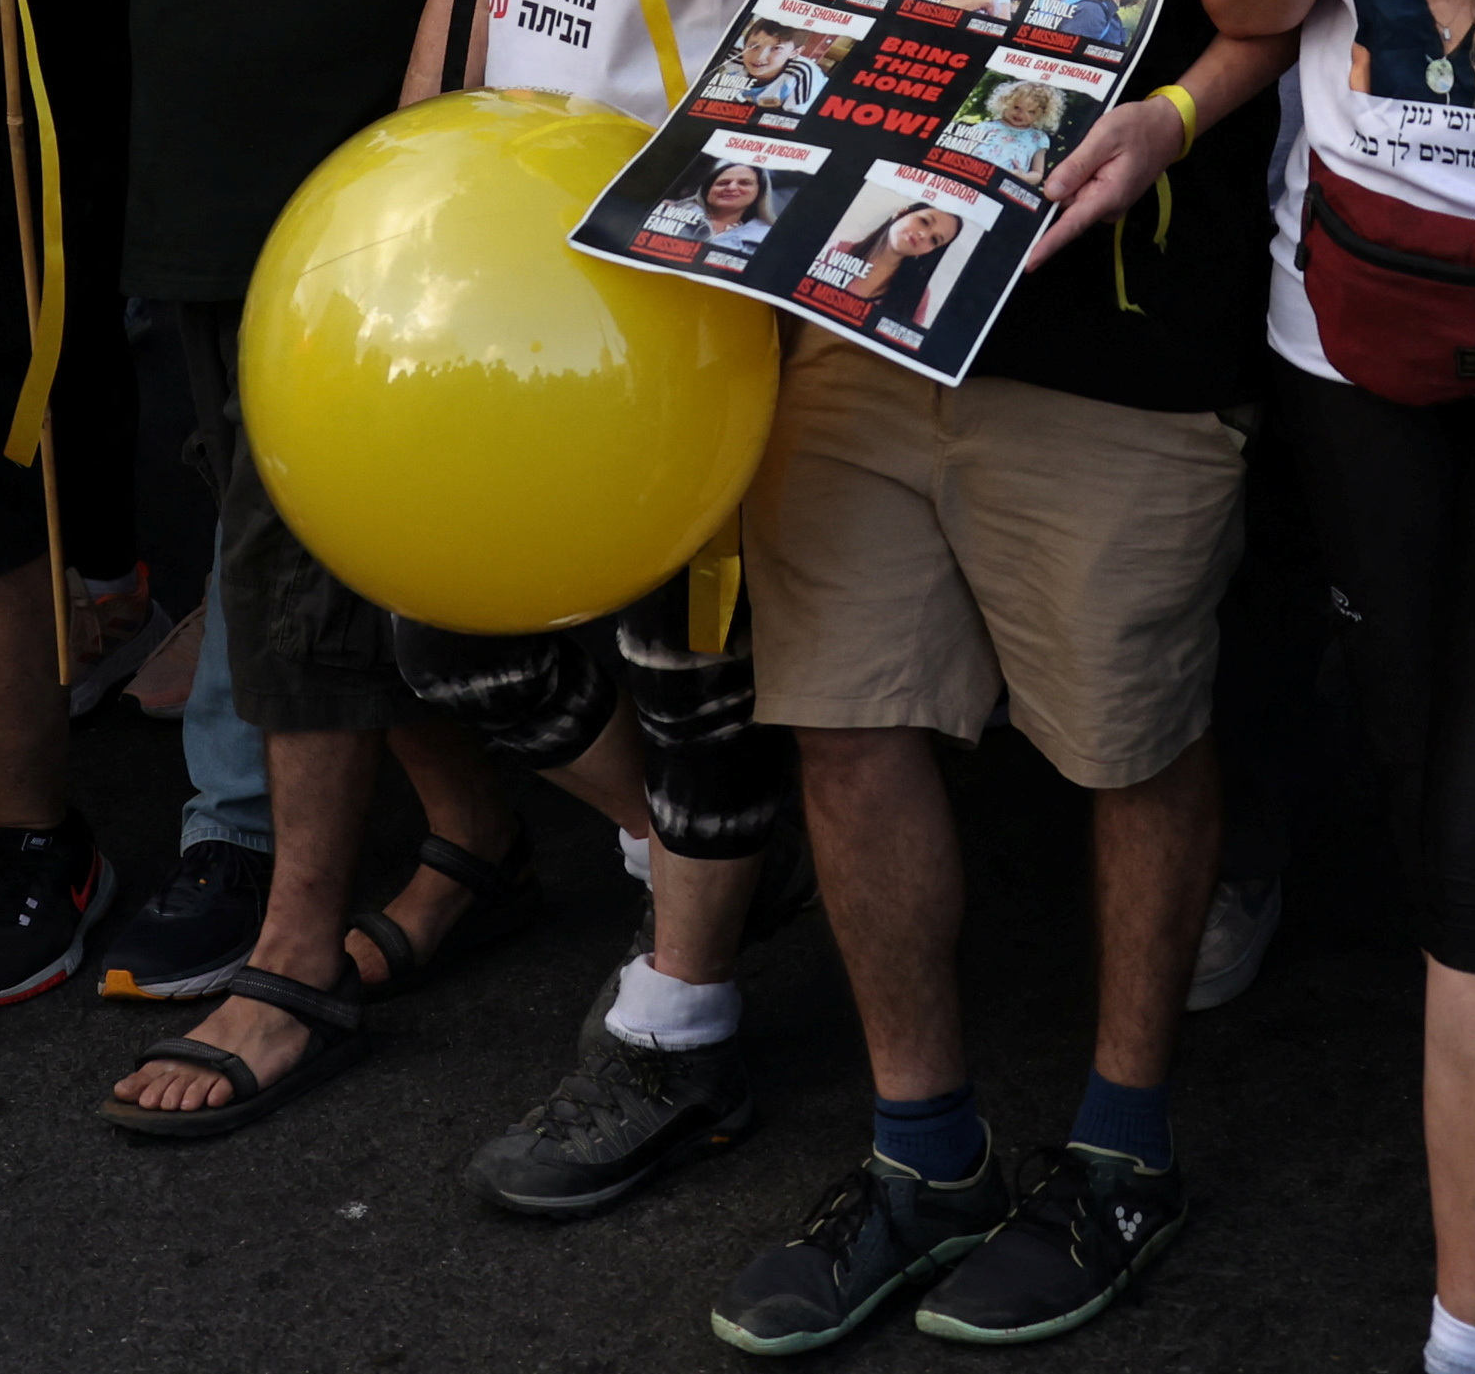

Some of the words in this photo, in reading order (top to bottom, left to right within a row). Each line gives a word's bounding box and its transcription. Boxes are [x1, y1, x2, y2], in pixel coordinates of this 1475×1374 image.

[518, 0, 592, 49] הביתה
[813, 5, 853, 26] SHOHAM
[880, 36, 969, 69] BRING
[874, 54, 956, 85] THEM
[853, 71, 943, 102] HOME
[818, 95, 941, 139] NOW!
[1401, 105, 1433, 130] גונן
[1387, 133, 1412, 167] לך
